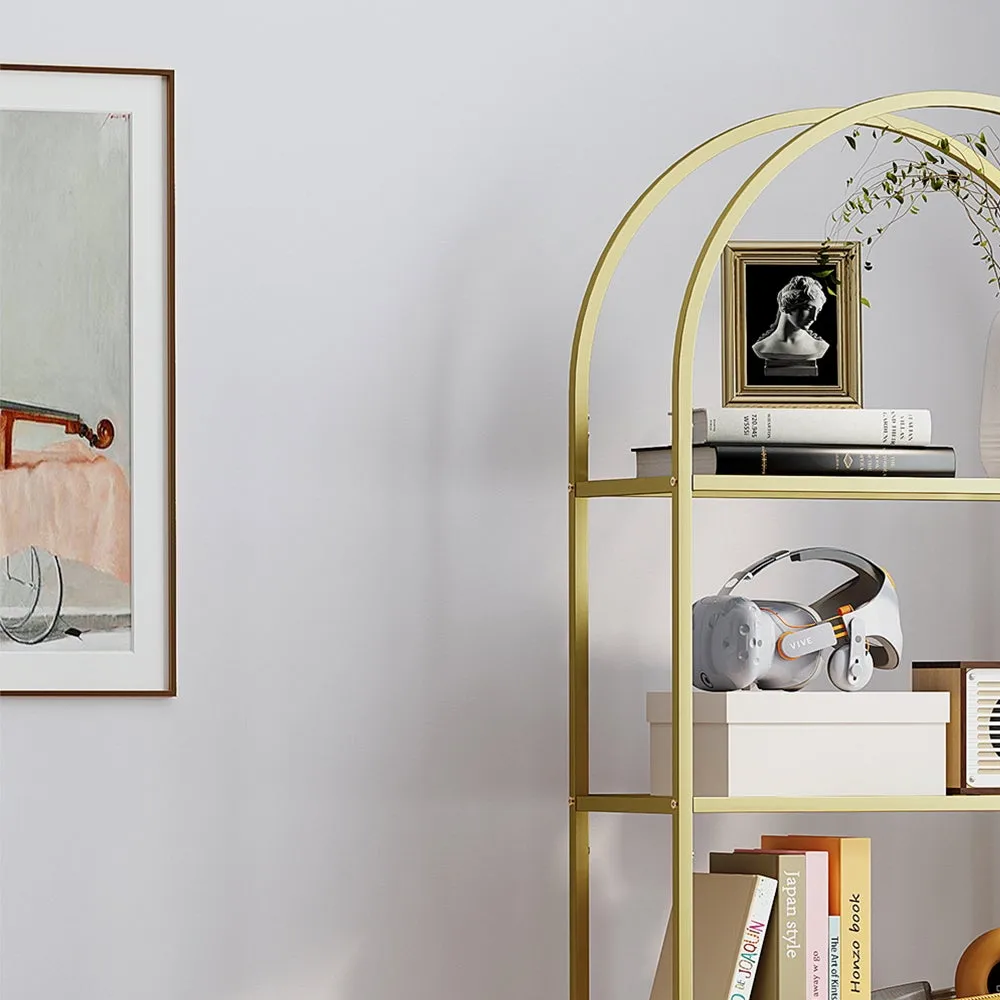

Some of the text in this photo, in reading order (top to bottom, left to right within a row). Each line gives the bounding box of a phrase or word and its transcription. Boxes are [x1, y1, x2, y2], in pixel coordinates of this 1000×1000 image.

[789, 637, 813, 649] VIVE
[782, 870, 800, 959] Japan style
[849, 893, 861, 932] book
[831, 936, 839, 952] The
[812, 950, 820, 962] go
[831, 954, 839, 967] Art
[831, 968, 839, 978] of
[850, 941, 861, 993] Honzo
[812, 974, 820, 997] away
